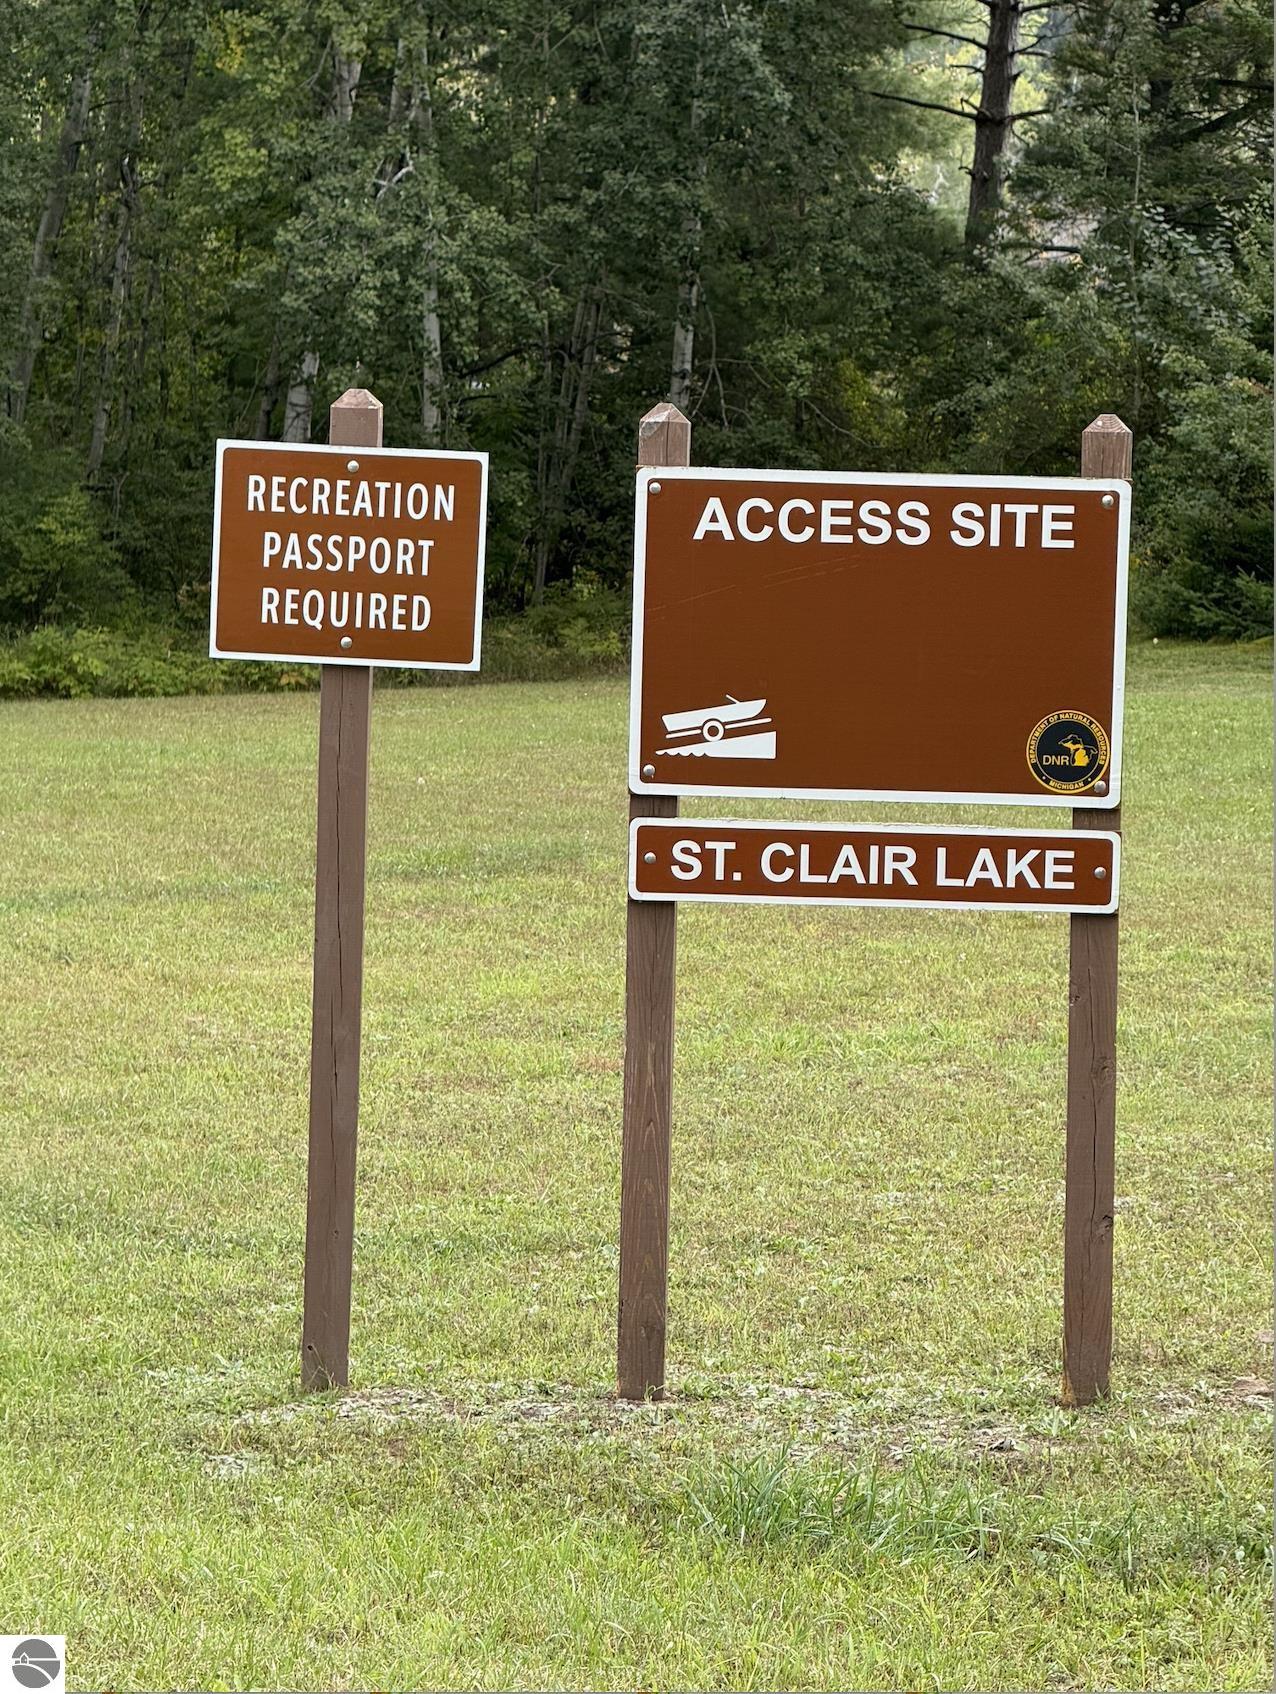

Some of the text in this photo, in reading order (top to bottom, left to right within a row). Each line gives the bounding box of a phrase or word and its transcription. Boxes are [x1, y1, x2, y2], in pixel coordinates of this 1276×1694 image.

[247, 474, 455, 521] RECREATION
[692, 497, 1075, 549] ACCESS SITE
[263, 531, 435, 576] PASSPORT
[261, 587, 431, 631] REQUIRED
[1029, 712, 1107, 765] DEPARTMENT OF NATURAL RESOURCES
[1042, 754, 1070, 766] DNR
[1049, 780, 1084, 790] MICHIGAN
[670, 839, 1075, 890] ST. CLAIR LAKE
